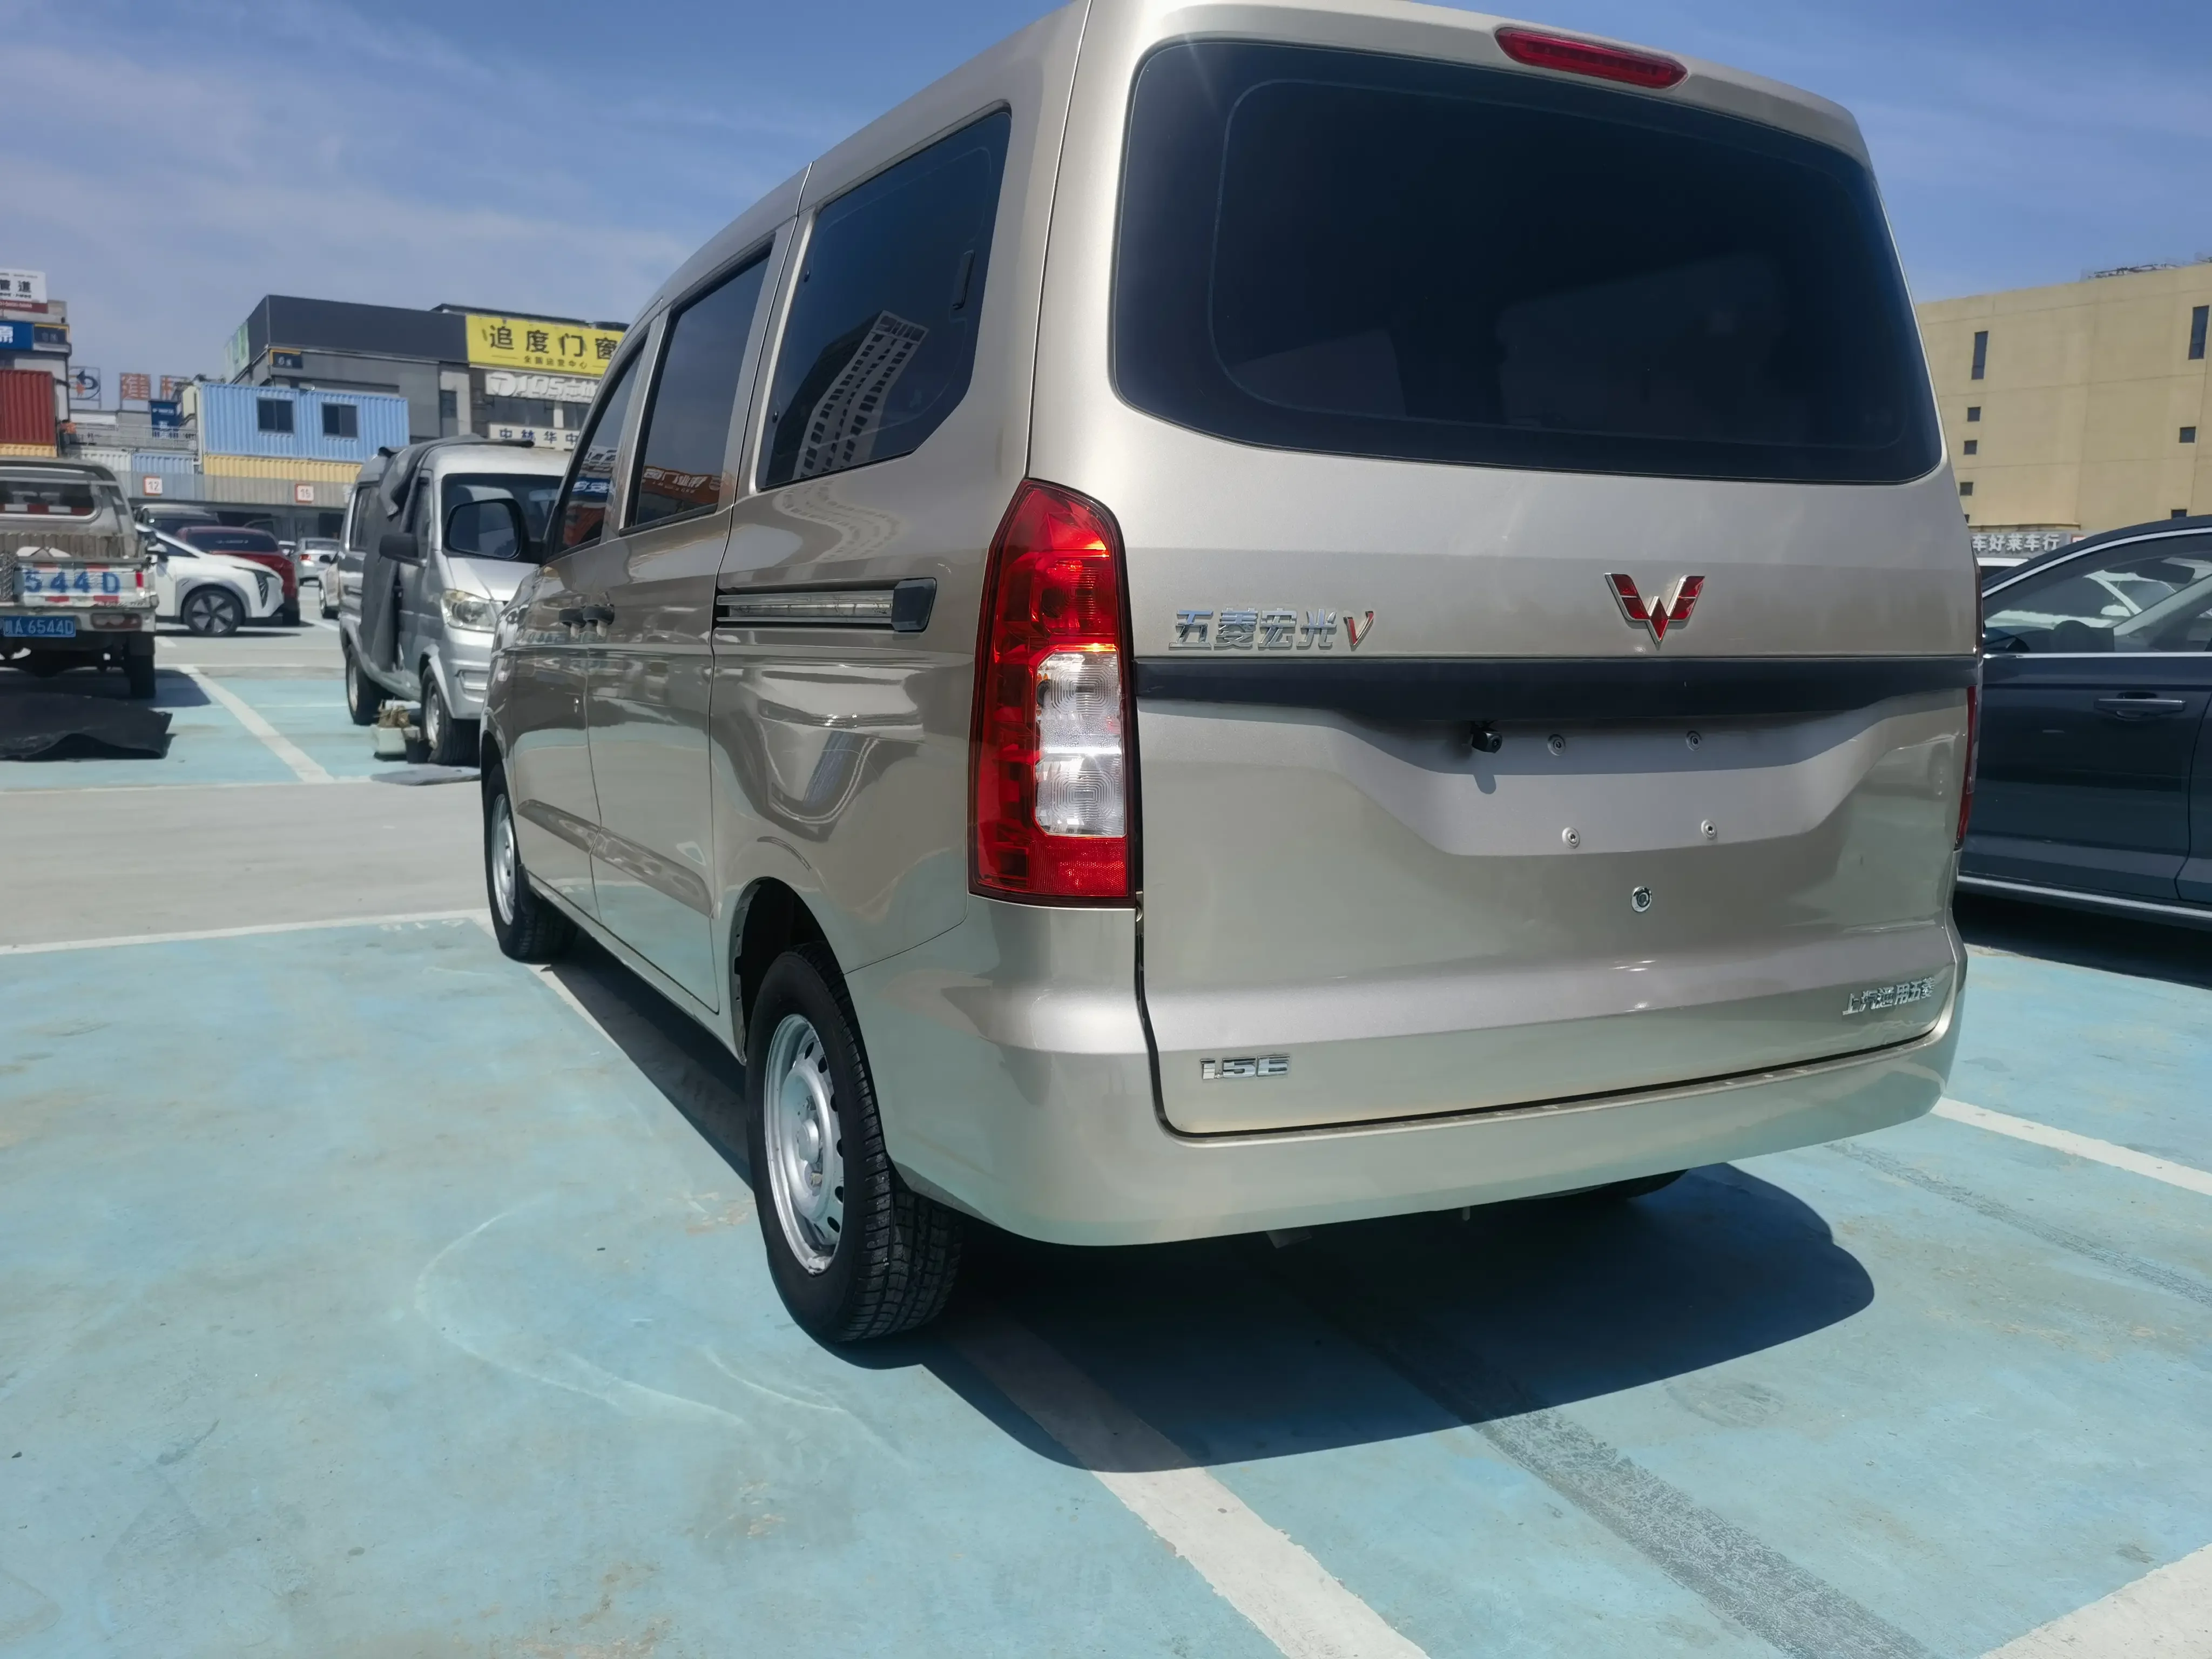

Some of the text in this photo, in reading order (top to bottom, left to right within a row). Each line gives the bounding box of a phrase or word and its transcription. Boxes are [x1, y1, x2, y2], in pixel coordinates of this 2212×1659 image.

[489, 325, 618, 360] 追度门窗
[1842, 976, 1936, 1016] 上汽通用五菱
